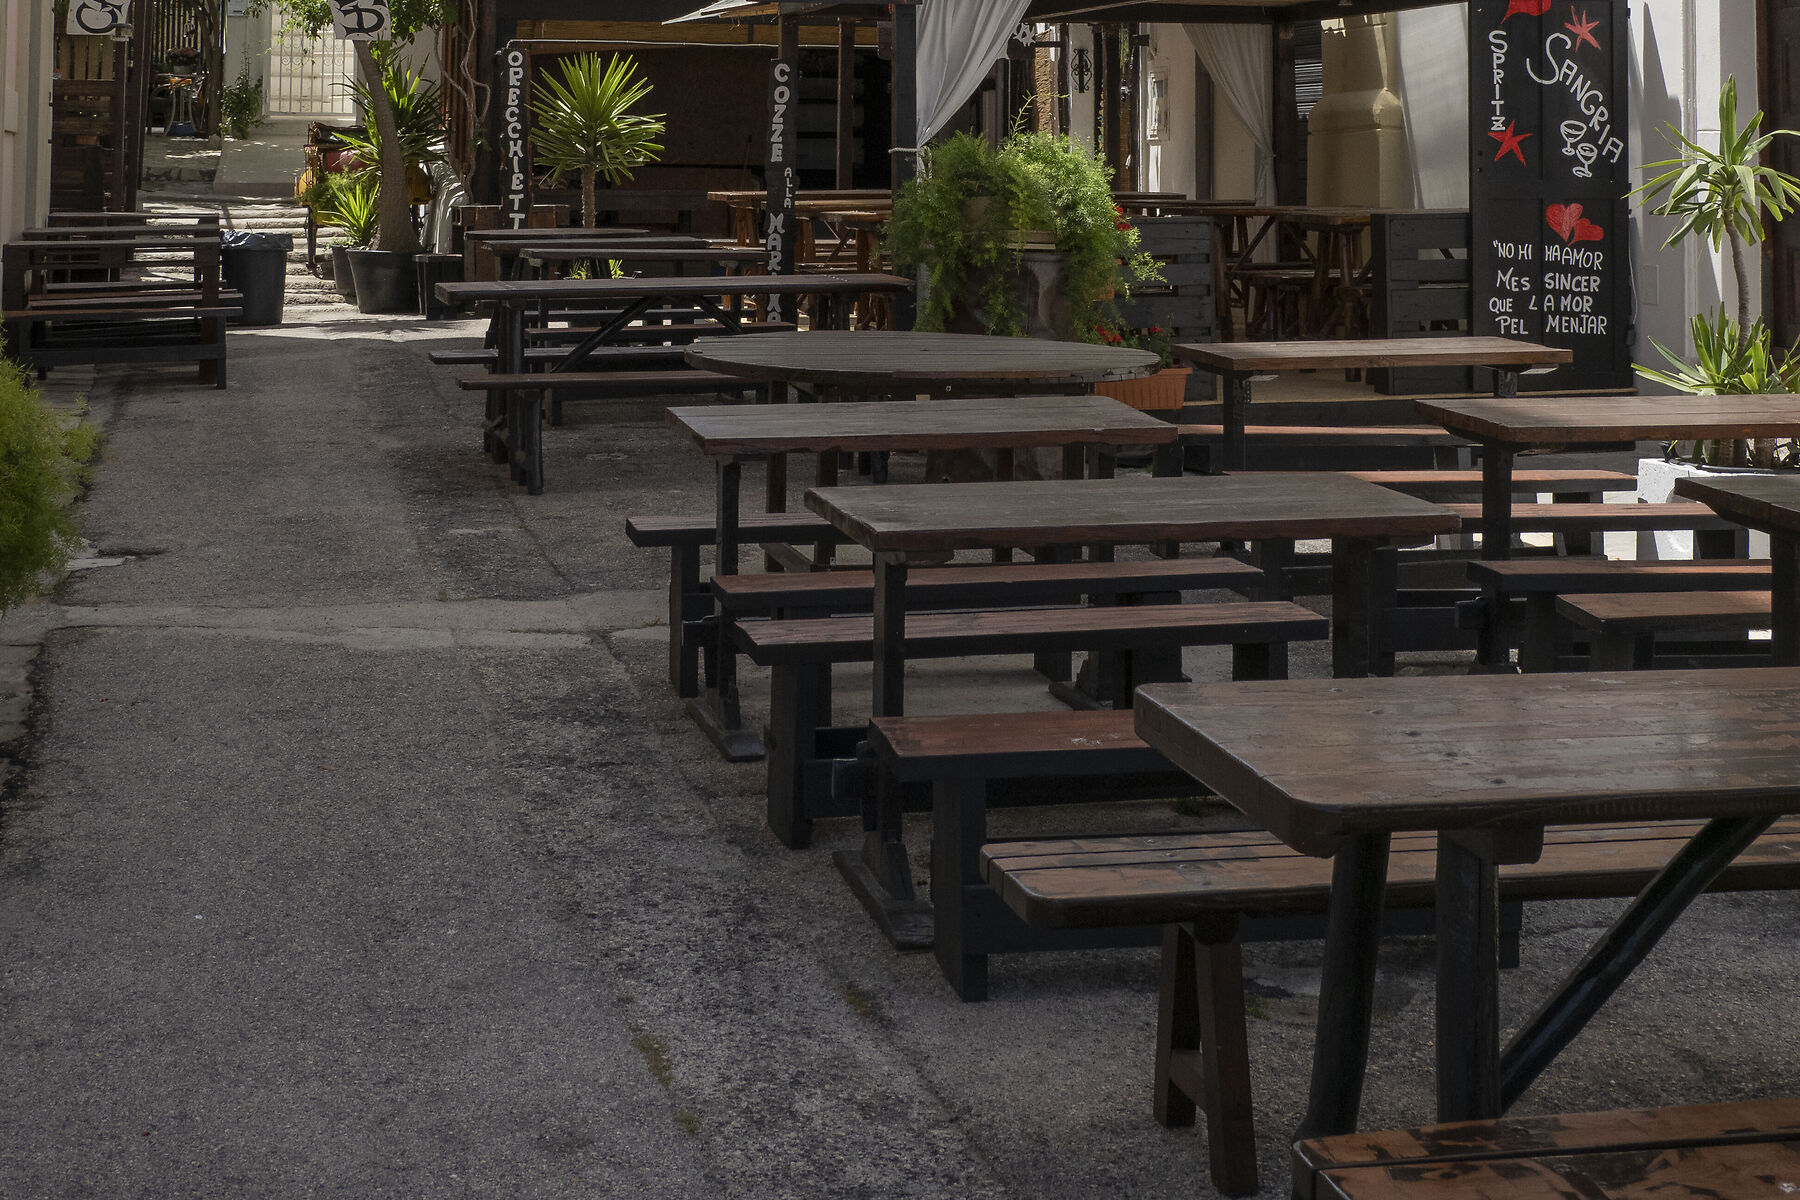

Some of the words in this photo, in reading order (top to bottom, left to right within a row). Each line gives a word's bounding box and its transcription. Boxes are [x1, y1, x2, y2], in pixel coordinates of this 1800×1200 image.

[1488, 30, 1508, 131] SPRITZ
[770, 63, 790, 162] COZZE
[1526, 33, 1624, 163] SANGRIA
[783, 167, 793, 208] ALLA
[1518, 244, 1532, 260] HI
[1496, 267, 1531, 292] MES
[1544, 272, 1601, 292] SINCER
[1489, 297, 1513, 314] QUE
[1495, 315, 1529, 334] PEL
[1545, 314, 1608, 335] MENJAR
